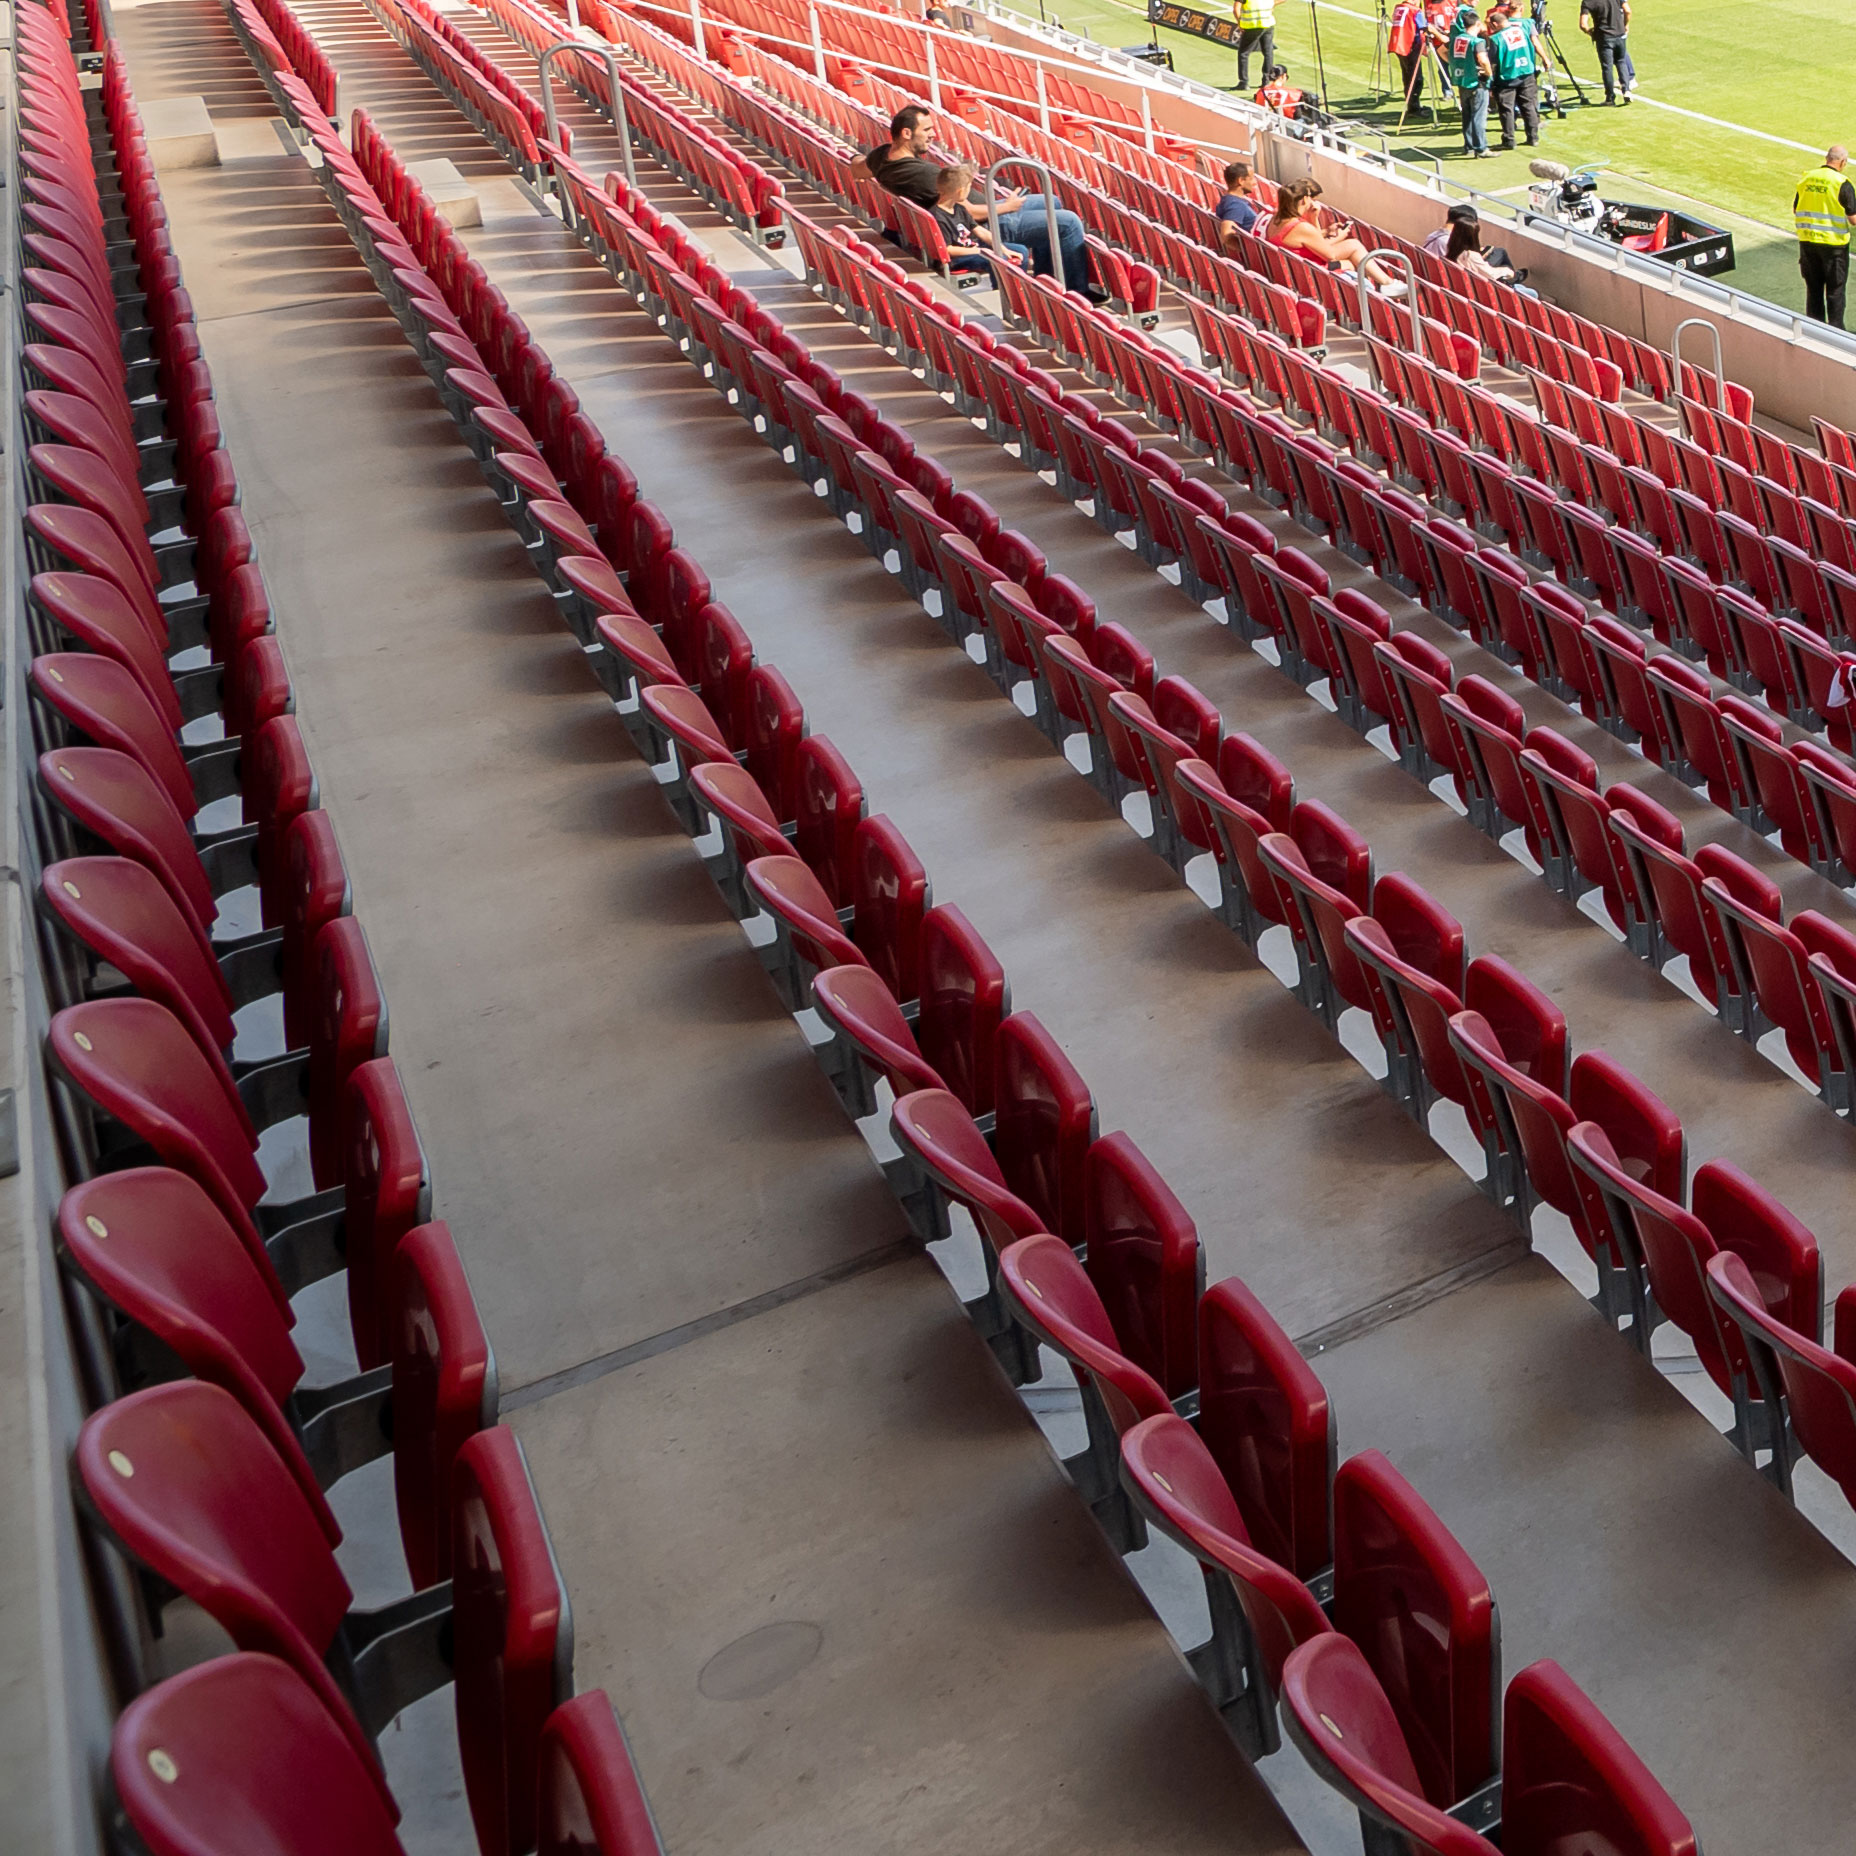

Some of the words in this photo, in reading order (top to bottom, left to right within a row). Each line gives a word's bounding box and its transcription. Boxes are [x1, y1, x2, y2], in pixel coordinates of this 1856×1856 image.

[1162, 6, 1180, 24] OPEL
[1187, 14, 1205, 31] OPEL
[1215, 22, 1233, 40] OPEL
